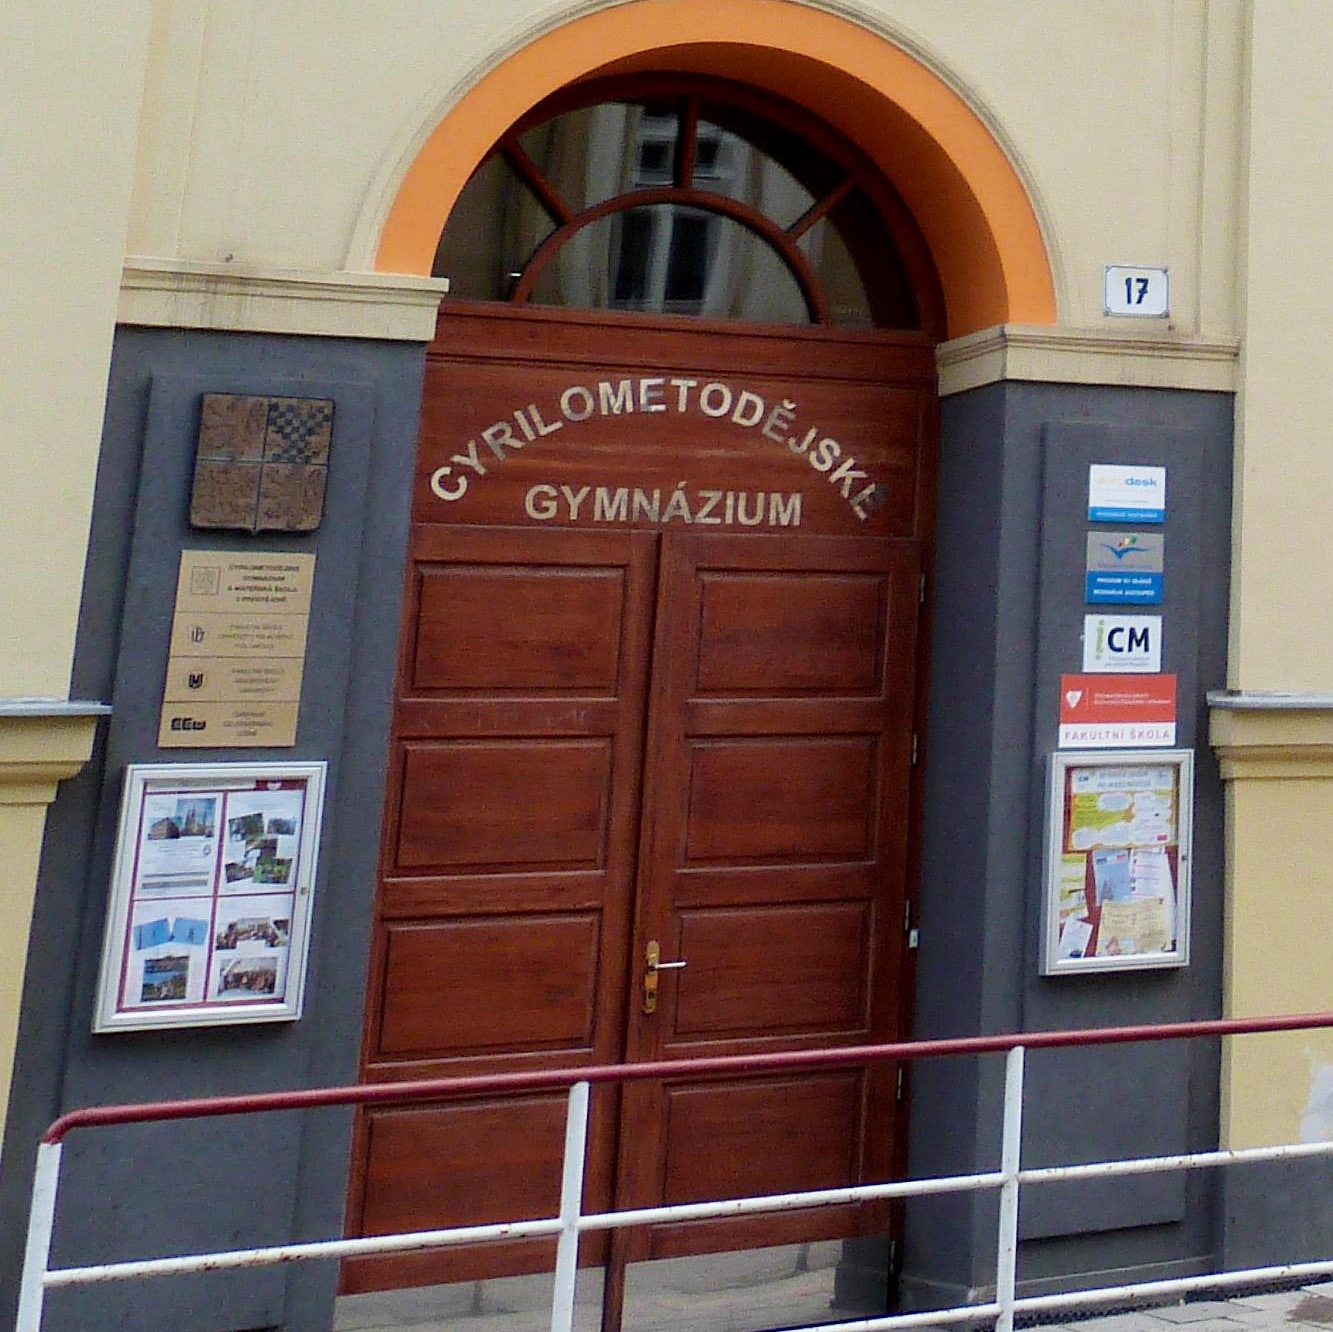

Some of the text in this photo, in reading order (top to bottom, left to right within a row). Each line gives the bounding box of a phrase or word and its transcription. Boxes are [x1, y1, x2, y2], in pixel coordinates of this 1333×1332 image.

[1125, 277, 1149, 304] 17
[524, 480, 802, 527] GYMNÁZIUM
[1065, 729, 1170, 741] FAKULTNÍ ŠKOLA
